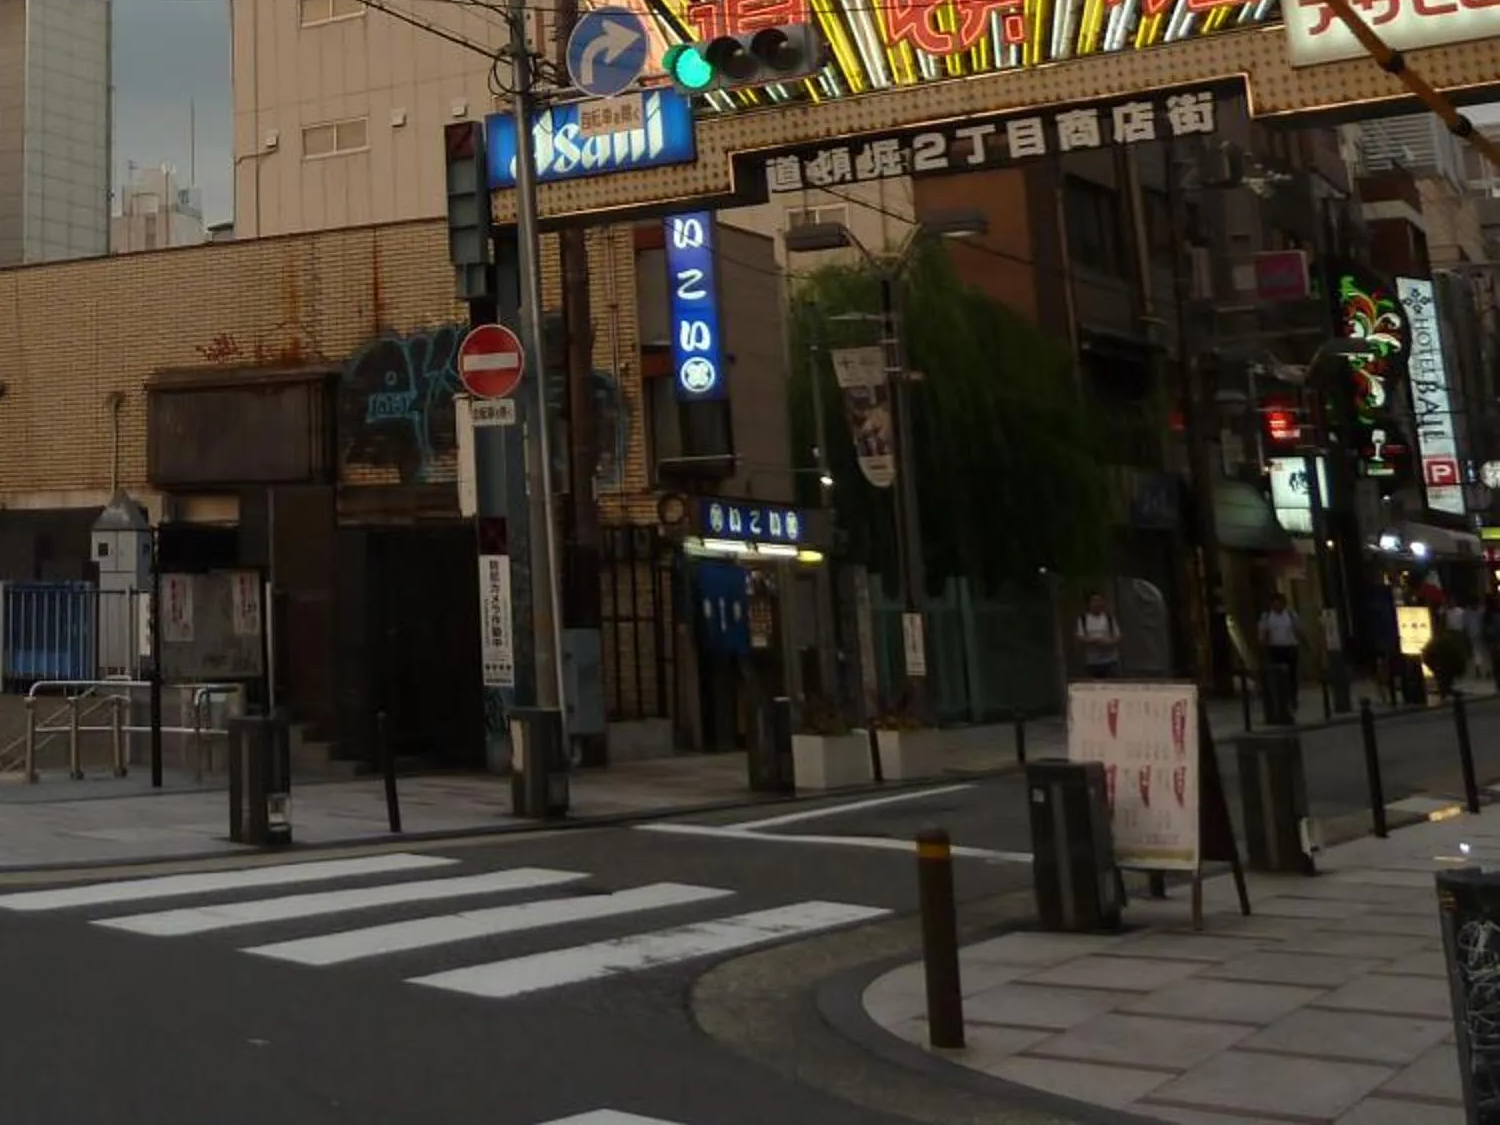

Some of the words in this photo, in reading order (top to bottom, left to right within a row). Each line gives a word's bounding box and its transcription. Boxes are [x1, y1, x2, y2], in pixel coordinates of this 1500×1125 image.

[765, 92, 1217, 194] 道頓堀2丁目商店街
[673, 218, 711, 351] いこい
[1414, 318, 1437, 376] HOTEL
[1431, 464, 1452, 483] P
